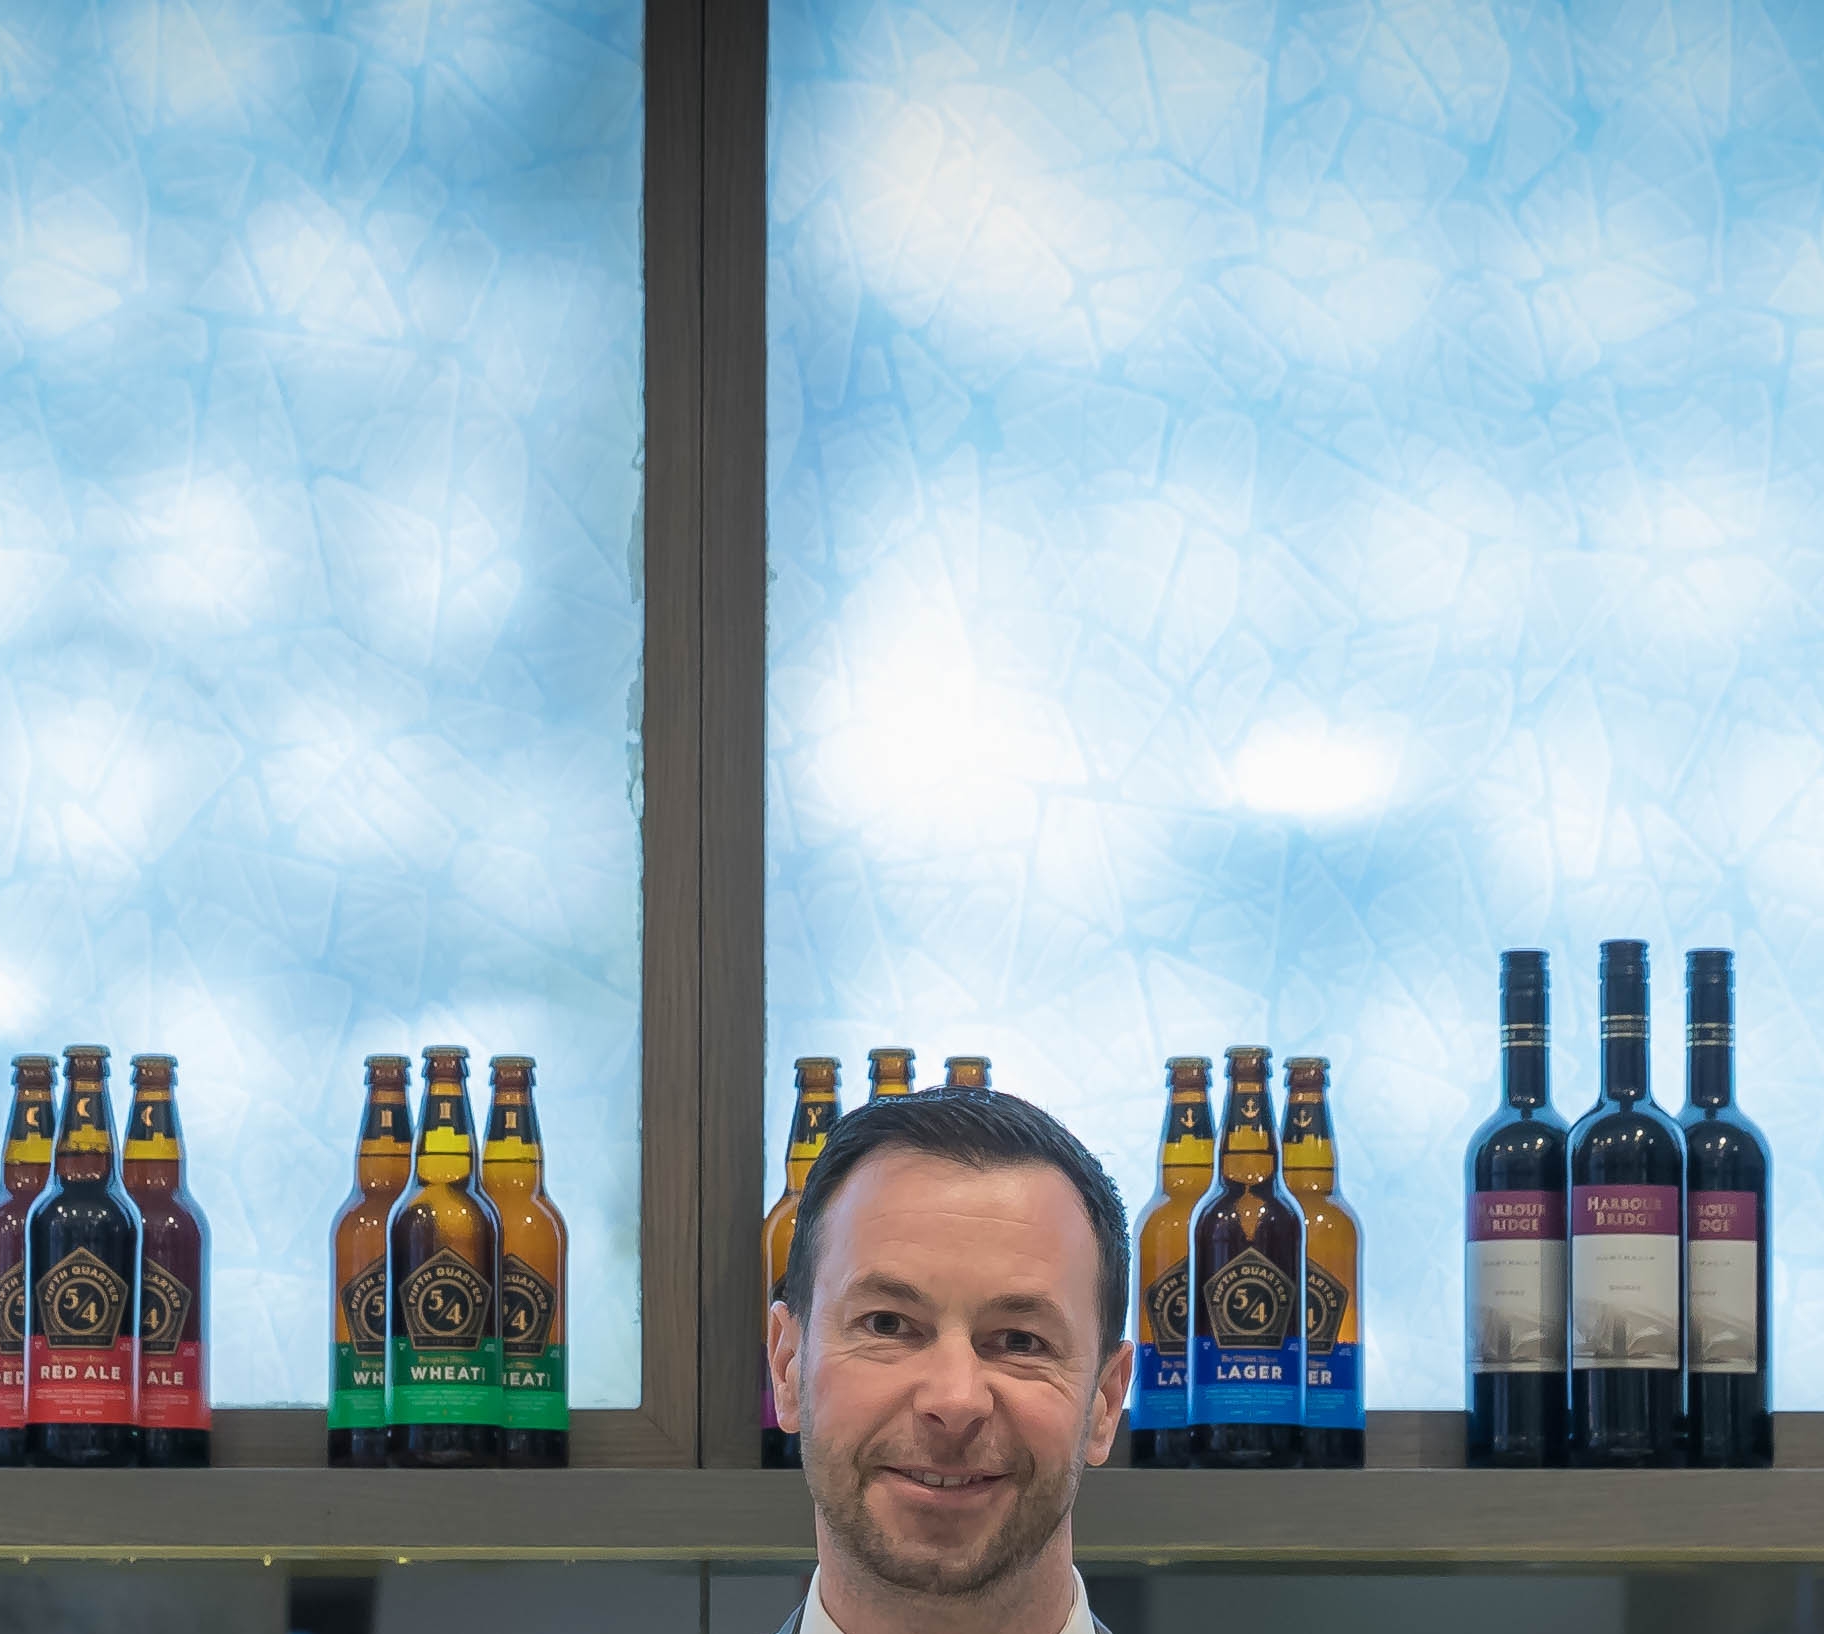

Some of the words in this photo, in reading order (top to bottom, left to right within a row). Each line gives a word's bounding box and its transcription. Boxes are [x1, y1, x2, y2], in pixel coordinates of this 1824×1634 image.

[1588, 1196, 1664, 1211] HARBOUR
[1596, 1212, 1656, 1227] BRIDGE
[1698, 1218, 1730, 1232] DGE
[45, 1269, 69, 1303] FIFTH
[71, 1265, 120, 1303] QUARTER
[408, 1271, 433, 1305] FIFTH
[436, 1266, 484, 1304] QUARTER
[505, 1274, 548, 1310] UARTER
[1213, 1270, 1238, 1303] FIFTH
[1240, 1266, 1288, 1302] QUARTER
[1308, 1276, 1337, 1308] ARTER
[63, 1288, 98, 1324] 5/4
[428, 1289, 462, 1325] 5/4
[1233, 1288, 1267, 1324] 5/4
[41, 1366, 77, 1380] RED
[84, 1366, 121, 1380] ALE
[146, 1371, 184, 1385] ALE
[410, 1366, 480, 1381] WHEAT
[502, 1372, 545, 1386] EAT
[1217, 1365, 1282, 1380] LAGER
